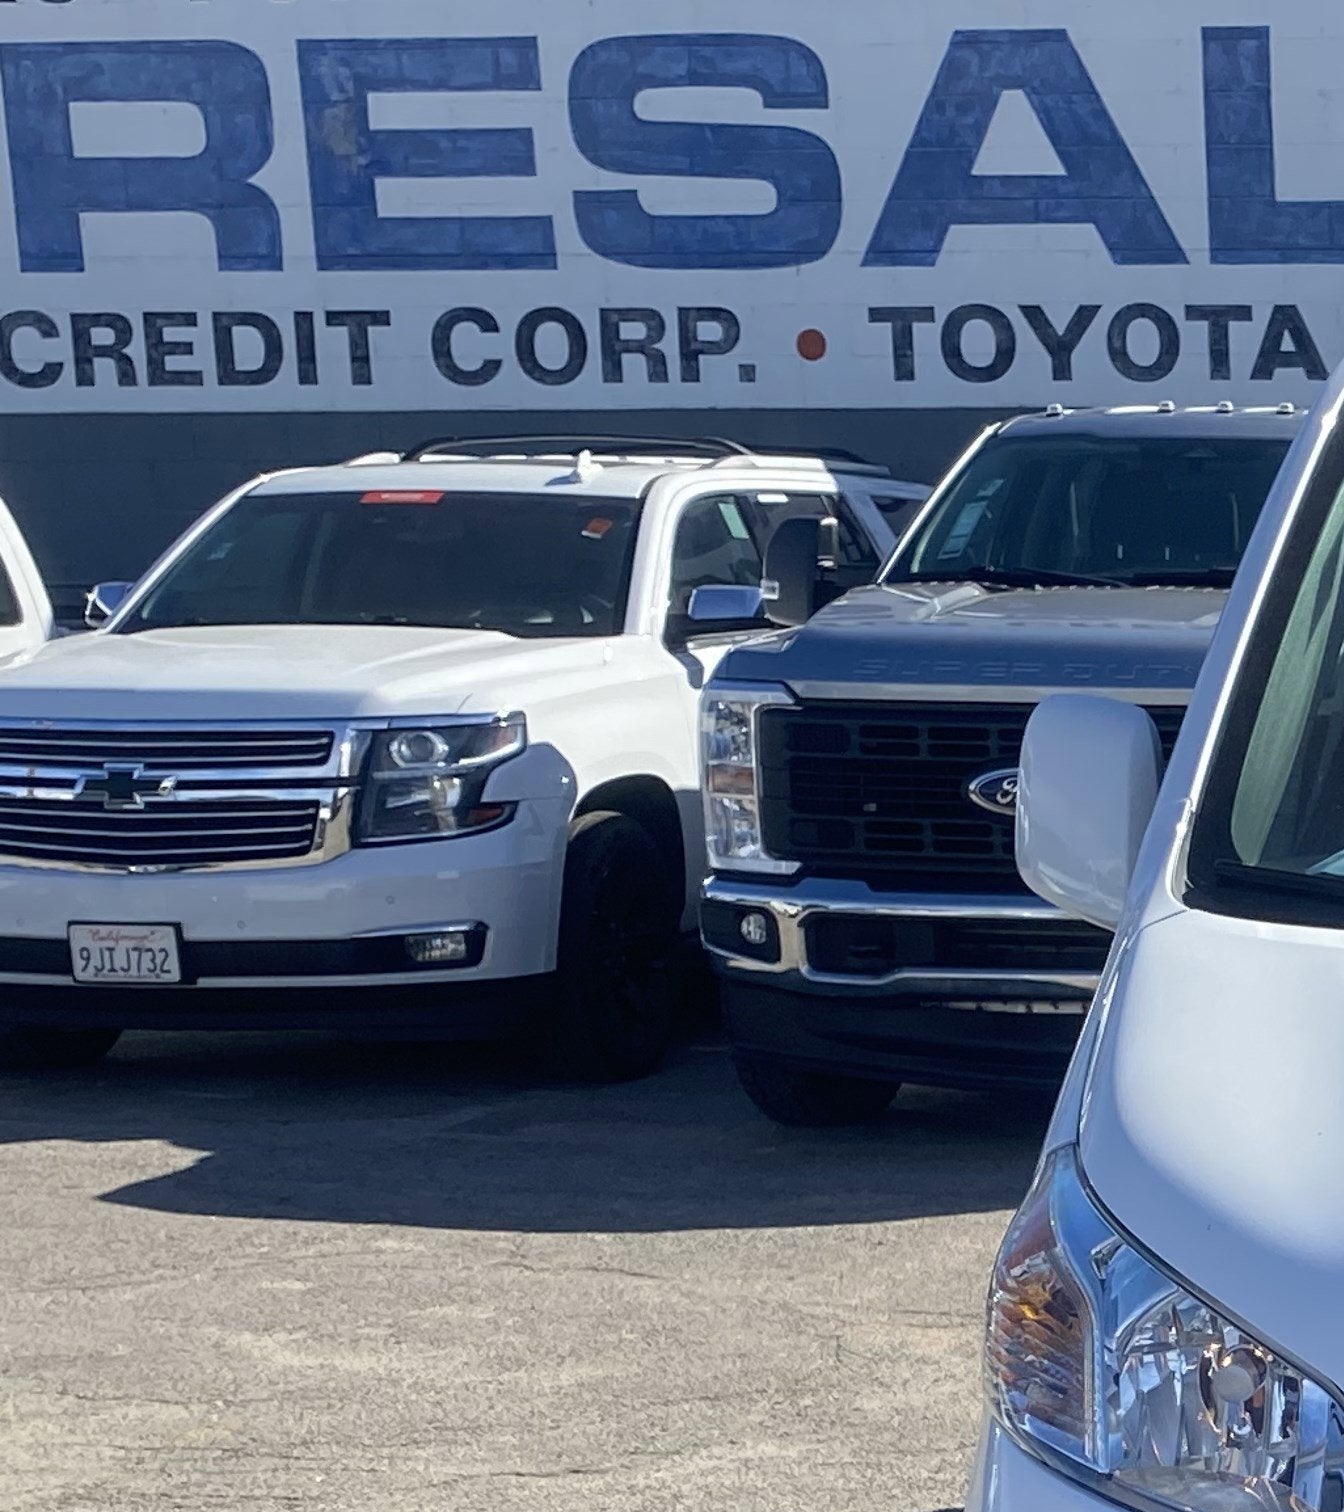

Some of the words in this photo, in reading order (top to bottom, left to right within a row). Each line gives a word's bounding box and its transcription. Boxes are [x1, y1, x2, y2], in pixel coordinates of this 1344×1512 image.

[0, 309, 391, 389] CREDIT
[431, 306, 757, 387] CORP.
[867, 303, 1330, 384] TOYOTA
